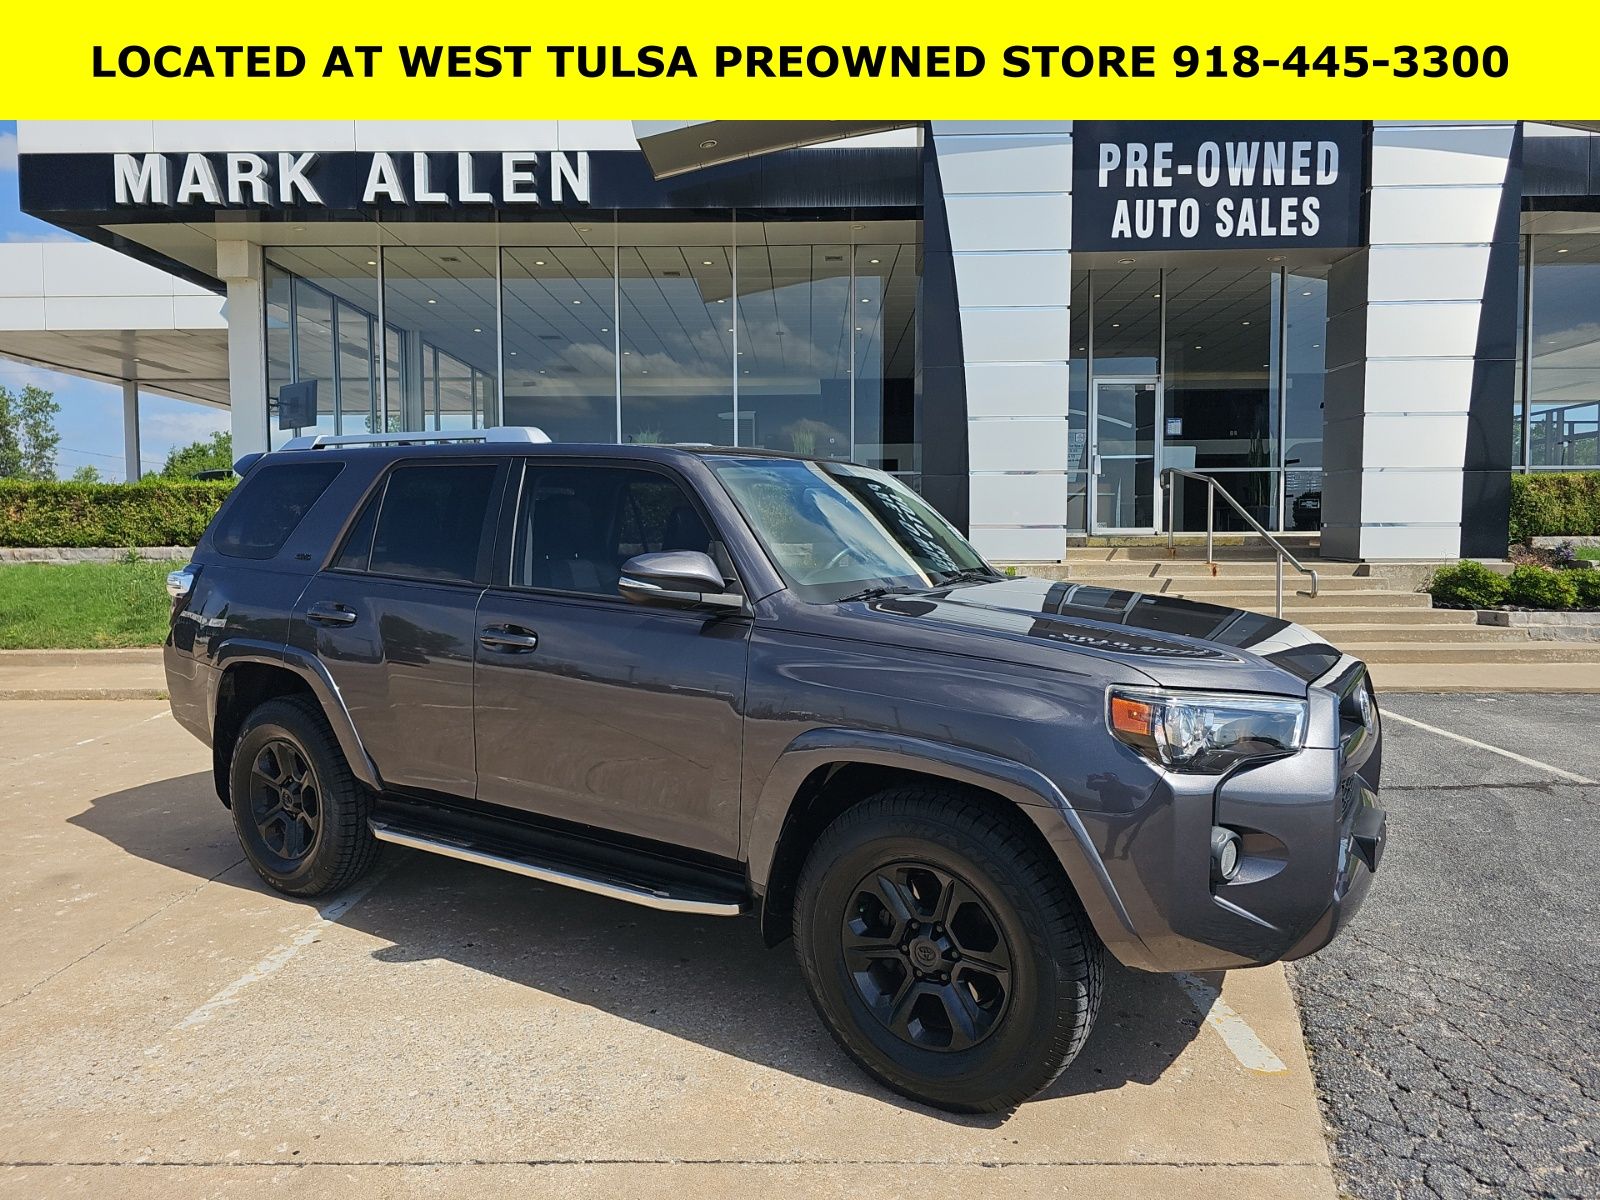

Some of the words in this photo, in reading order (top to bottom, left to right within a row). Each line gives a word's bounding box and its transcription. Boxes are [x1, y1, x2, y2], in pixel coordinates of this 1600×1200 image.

[113, 152, 326, 206] MARK
[362, 151, 591, 204] ALLEN
[1098, 141, 1339, 188] PRE-OWNED
[1111, 197, 1200, 239] AUTO
[1215, 196, 1321, 238] SALES
